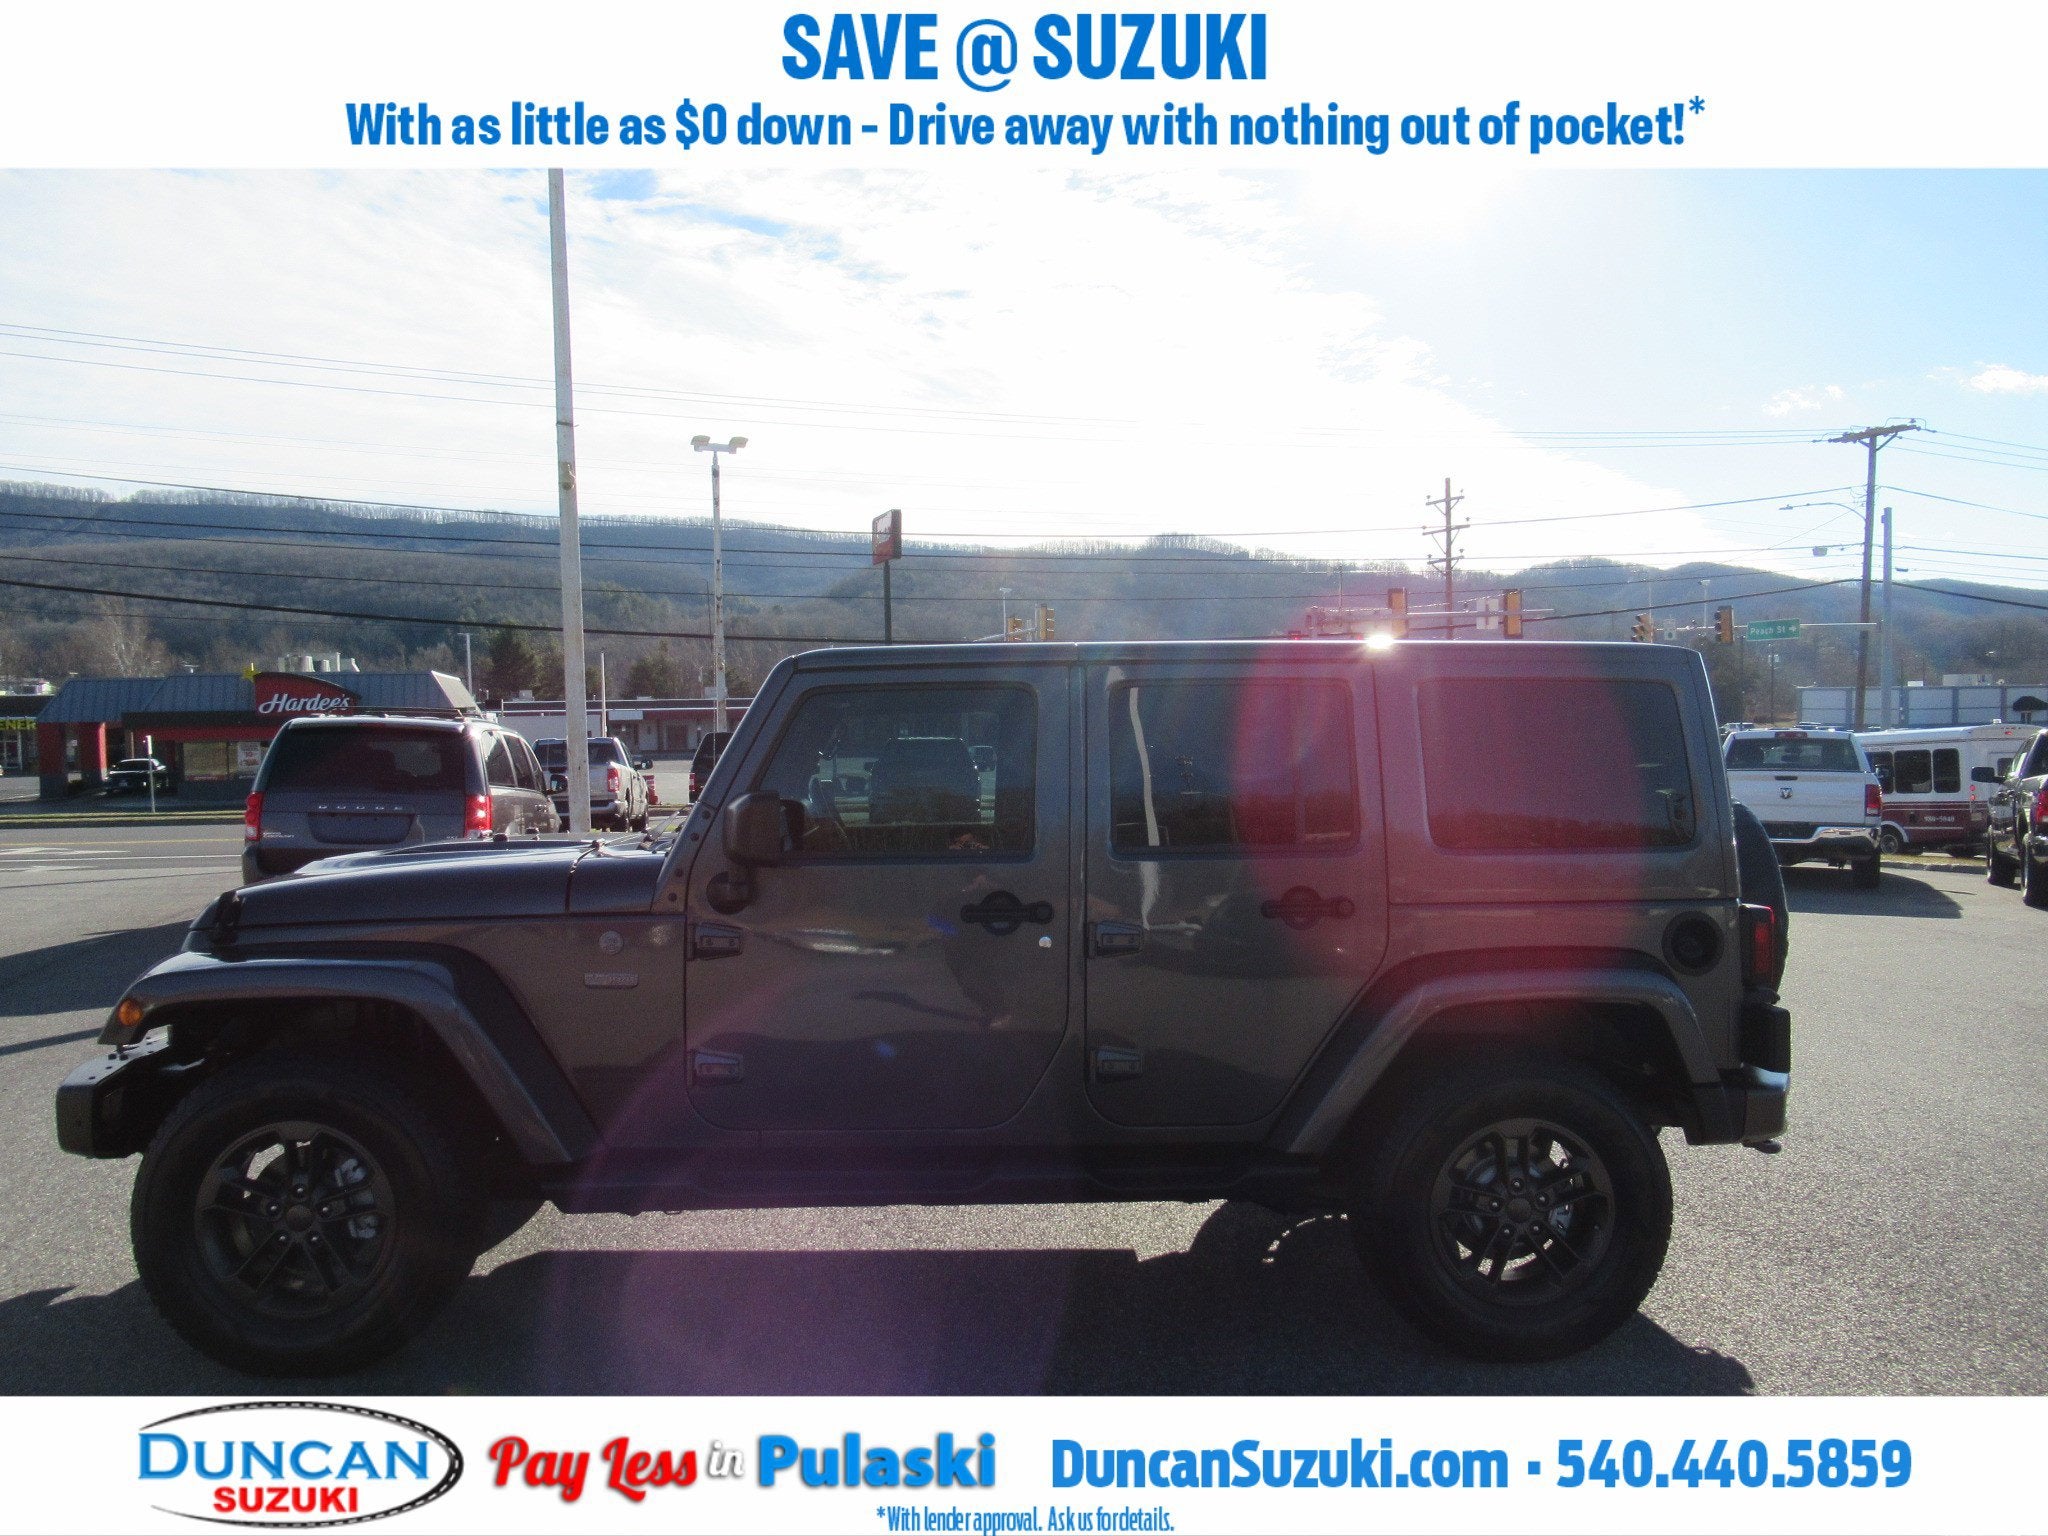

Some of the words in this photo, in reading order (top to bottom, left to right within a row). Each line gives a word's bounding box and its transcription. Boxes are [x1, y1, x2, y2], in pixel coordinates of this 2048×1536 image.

[1750, 627, 1774, 635] Peach
[1776, 625, 1785, 633] St
[259, 693, 350, 714] Hardee's
